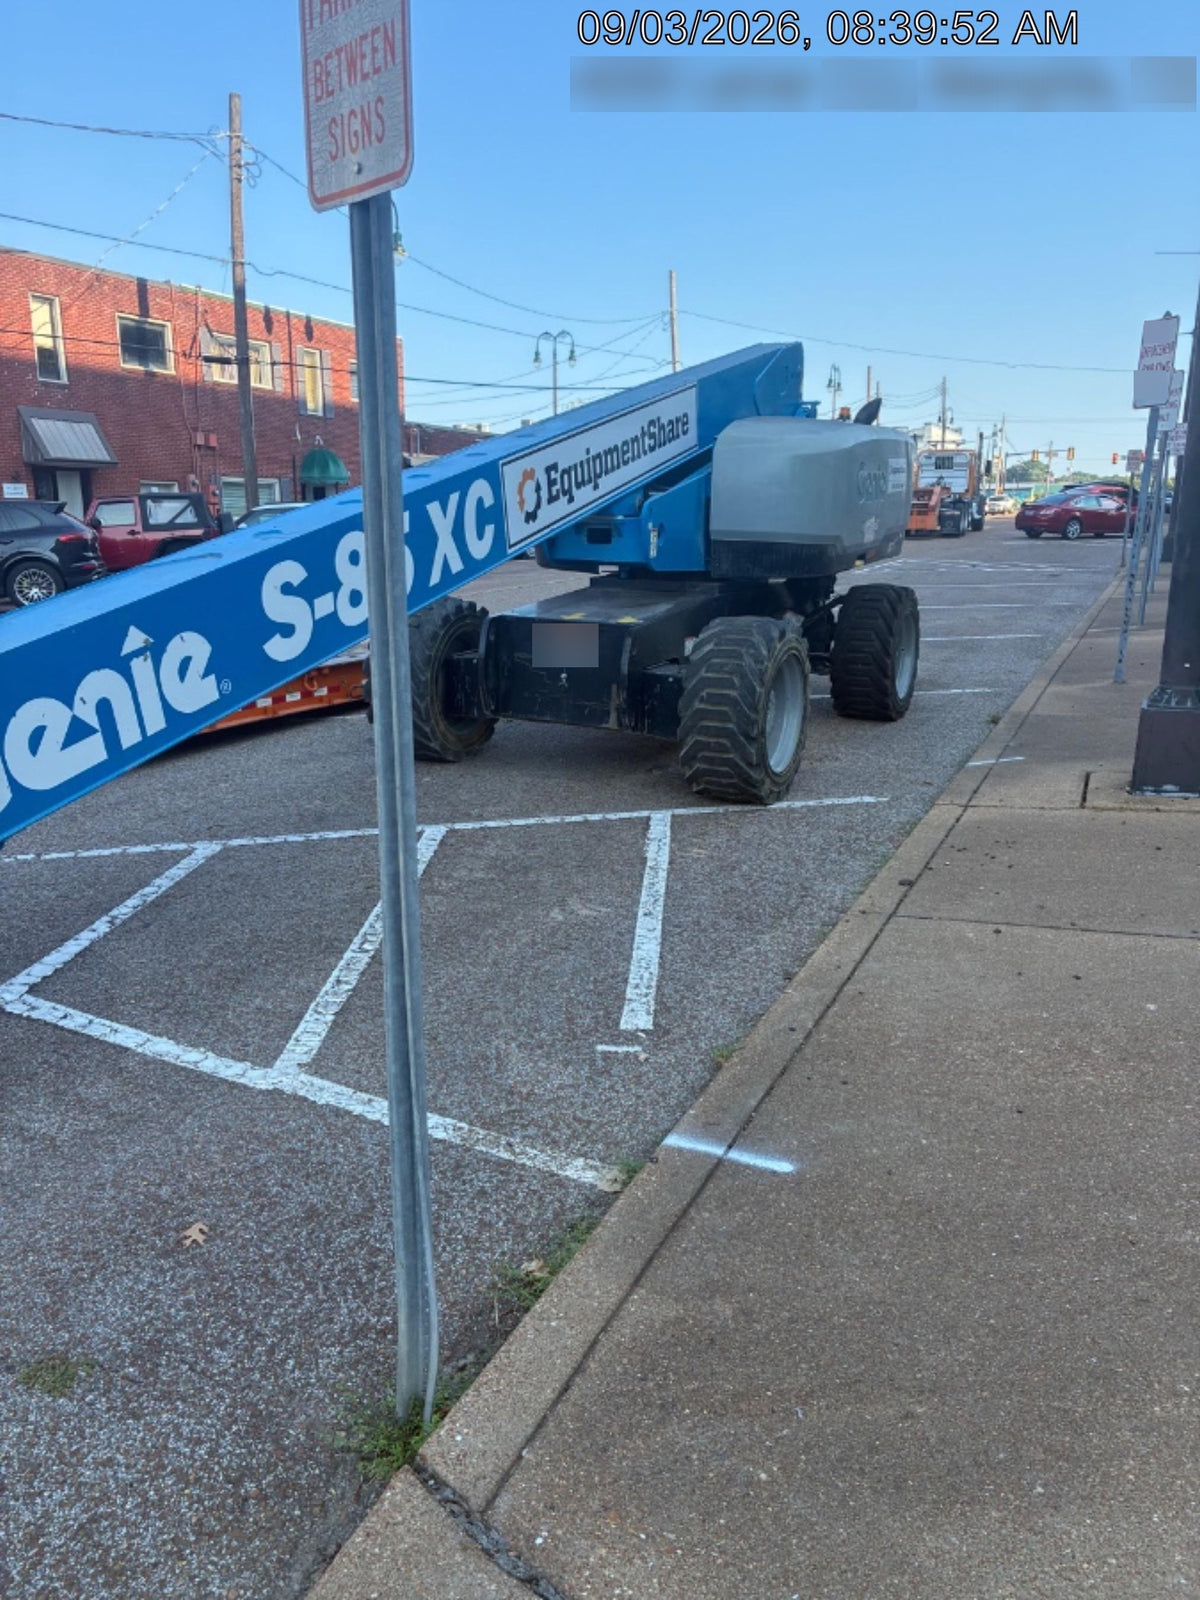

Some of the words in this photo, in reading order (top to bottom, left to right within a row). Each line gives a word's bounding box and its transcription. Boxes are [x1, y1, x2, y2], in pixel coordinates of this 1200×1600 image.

[312, 18, 396, 103] BETWEEN
[327, 95, 386, 163] SIGNS
[544, 411, 690, 506] EquipmentShare
[0, 624, 221, 813] enie
[261, 510, 415, 662] S-8
[425, 477, 496, 588] XC
